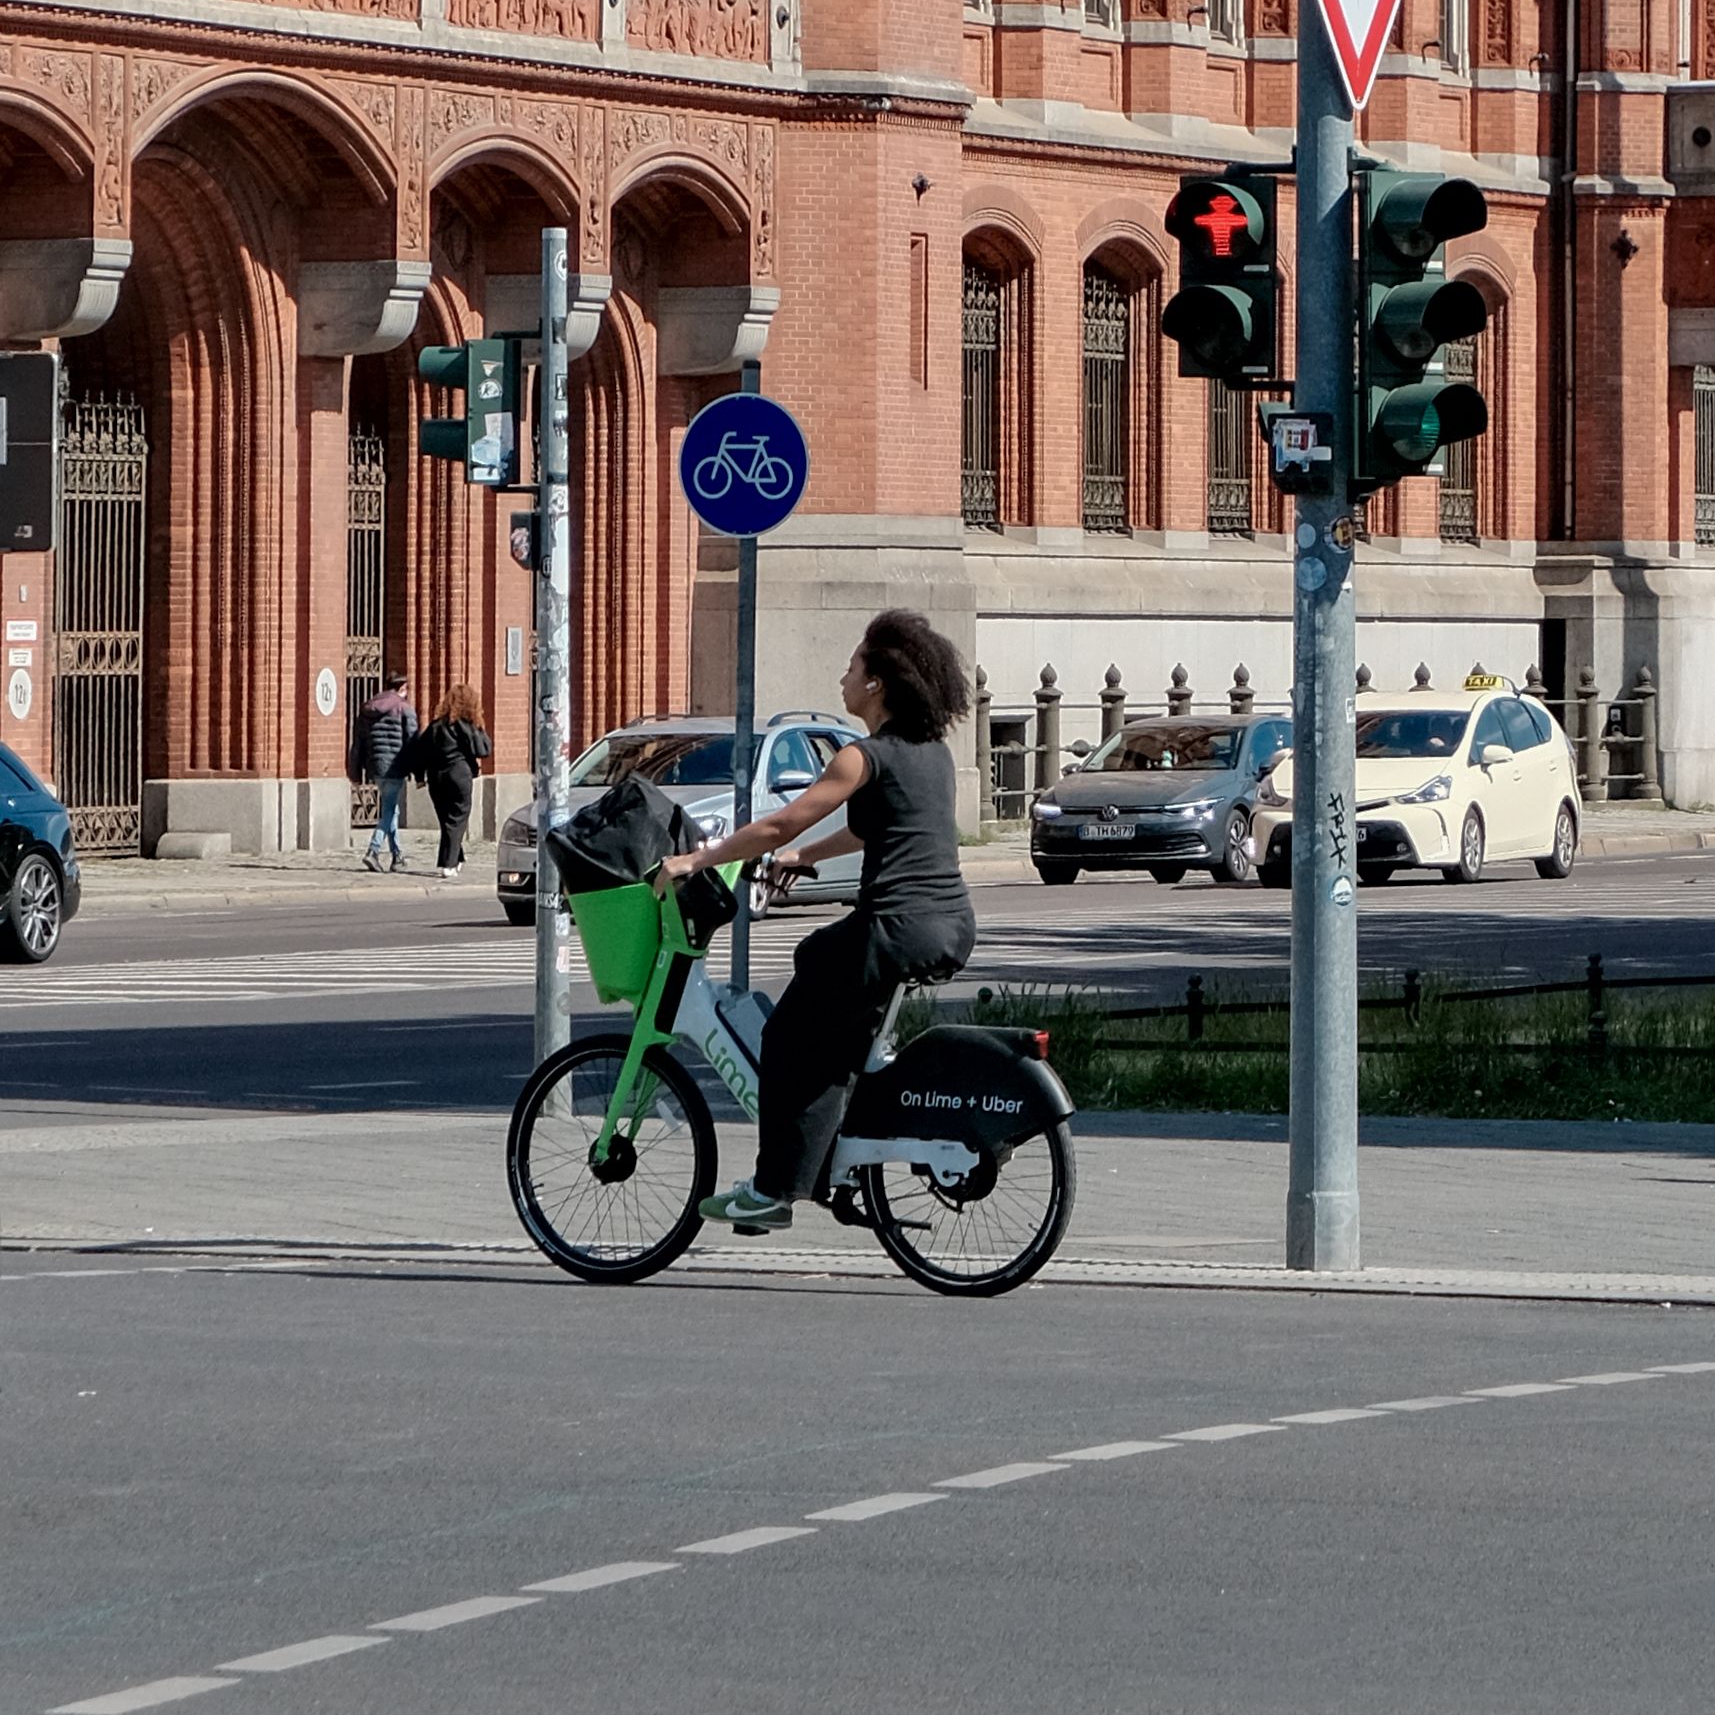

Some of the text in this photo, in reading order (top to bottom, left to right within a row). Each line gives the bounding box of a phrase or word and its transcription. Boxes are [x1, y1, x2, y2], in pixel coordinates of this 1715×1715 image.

[1468, 676, 1496, 687] TAXI
[704, 1027, 760, 1123] Lime
[900, 1090, 922, 1107] On
[924, 1090, 962, 1110] Lime
[981, 1094, 1024, 1115] Uber
